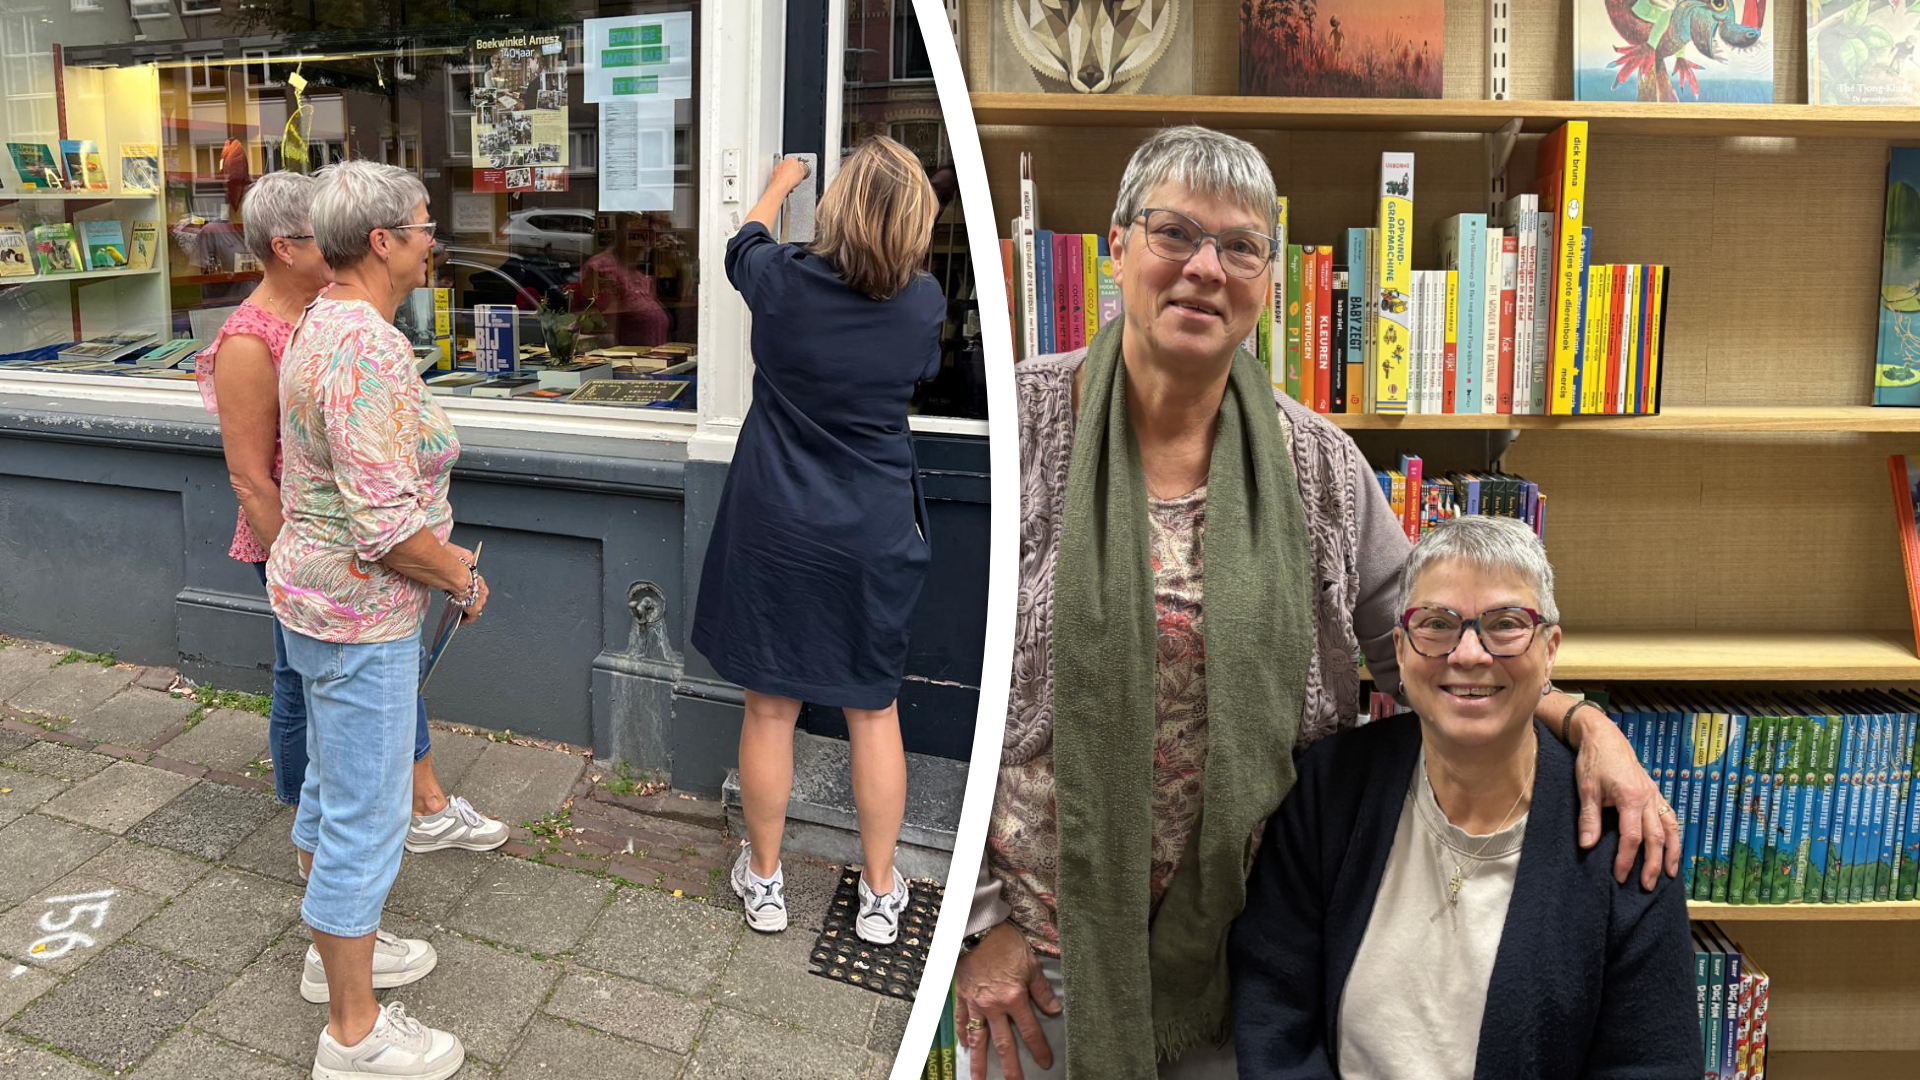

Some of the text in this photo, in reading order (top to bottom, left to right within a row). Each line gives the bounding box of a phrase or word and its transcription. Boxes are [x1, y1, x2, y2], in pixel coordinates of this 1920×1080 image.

[476, 35, 561, 50] Boekwinkel Amesz
[1571, 137, 1582, 187] dick bruna
[1386, 201, 1396, 282] GRAAFMACHINE
[1397, 218, 1405, 265] OPWIND-
[1488, 285, 1498, 296] HET
[1074, 315, 1080, 323] IN
[1104, 299, 1116, 321] TJ
[1336, 299, 1344, 317] baby
[1488, 300, 1498, 325] WONDER
[1560, 234, 1576, 399] nijntjes grote dierenboek mercis
[1303, 301, 1313, 360] VOERTUIGEN
[1350, 296, 1363, 352] BABY ZEGT
[1487, 329, 1496, 341] VAN
[475, 327, 499, 350] BIJ
[1288, 327, 1300, 354] PIT
[1319, 315, 1329, 370] KLEUREN
[1487, 343, 1495, 351] DE
[1501, 336, 1511, 353] Kok
[1533, 318, 1547, 383] LENTE MET MUIS
[476, 349, 500, 373] BEL
[1446, 353, 1455, 372] Kijk!
[1486, 354, 1495, 383] KASTANJE
[1658, 721, 1666, 736] PAUL
[1752, 727, 1760, 742] PAUL
[1643, 746, 1651, 764] LOON
[1698, 747, 1706, 765] LOON
[1714, 723, 1725, 767] PAUL LOON
[1731, 725, 1742, 768] PAUL LOON
[1764, 726, 1775, 769] PAUL LOON
[1778, 726, 1789, 769] PAUL LOON
[1792, 726, 1803, 769] PAUL LOON
[1810, 725, 1820, 768] PAUL LOON
[1828, 725, 1839, 769] PAUL LOON
[1844, 751, 1852, 769] LOON
[1690, 781, 1702, 824] SUPERDOLFJE
[1697, 984, 1707, 1001] DOG
[1711, 984, 1723, 1001] DOG
[1727, 983, 1740, 1001] DOG
[1710, 1002, 1721, 1019] MAN
[1727, 1002, 1738, 1020] MAN
[928, 1050, 938, 1080] DAGF
[943, 1048, 953, 1080] DAGFR
